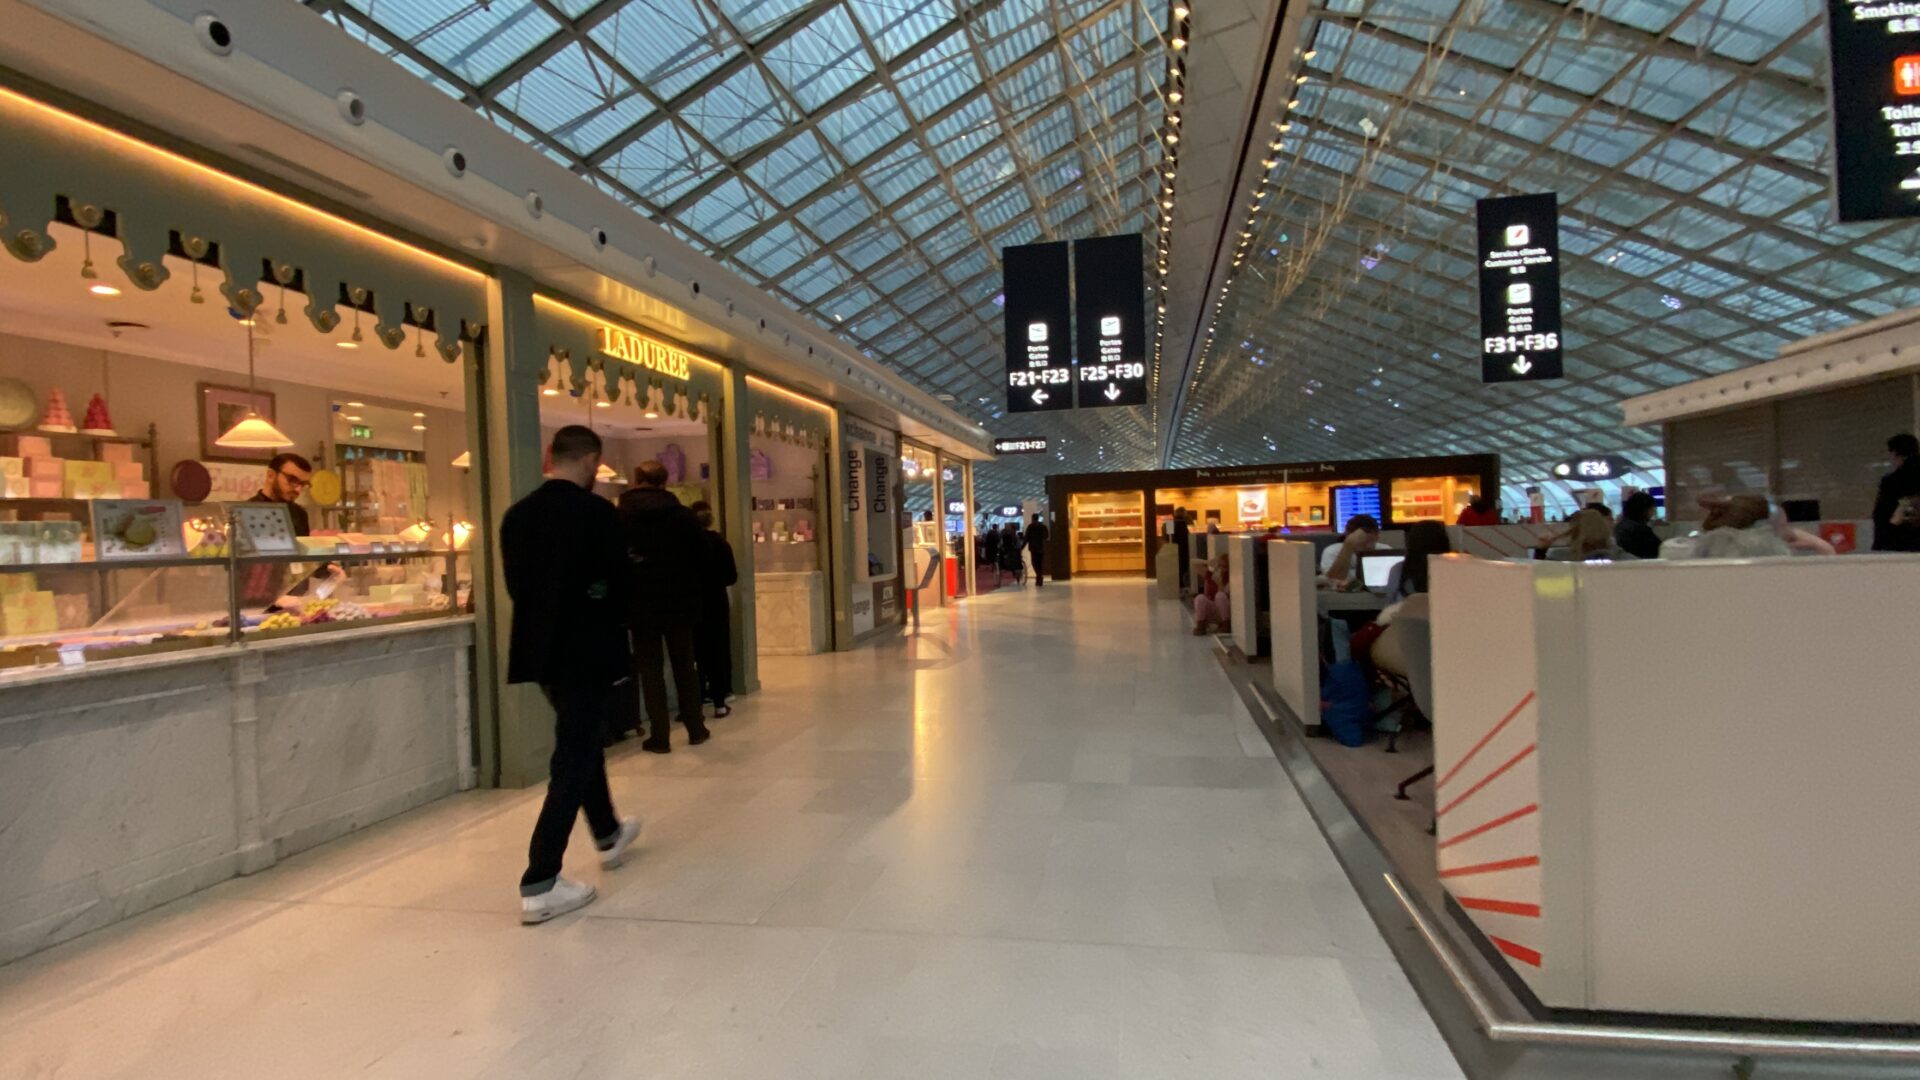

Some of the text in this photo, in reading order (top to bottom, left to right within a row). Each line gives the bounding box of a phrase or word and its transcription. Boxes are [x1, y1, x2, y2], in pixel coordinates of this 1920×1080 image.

[1484, 332, 1559, 354] F31-F36
[1009, 368, 1070, 387] F21-F23
[1080, 362, 1144, 382] F25-F30
[1016, 441, 1046, 450] F21-F23
[1579, 461, 1610, 476] F36
[848, 449, 863, 512] Change
[873, 457, 889, 513] Change
